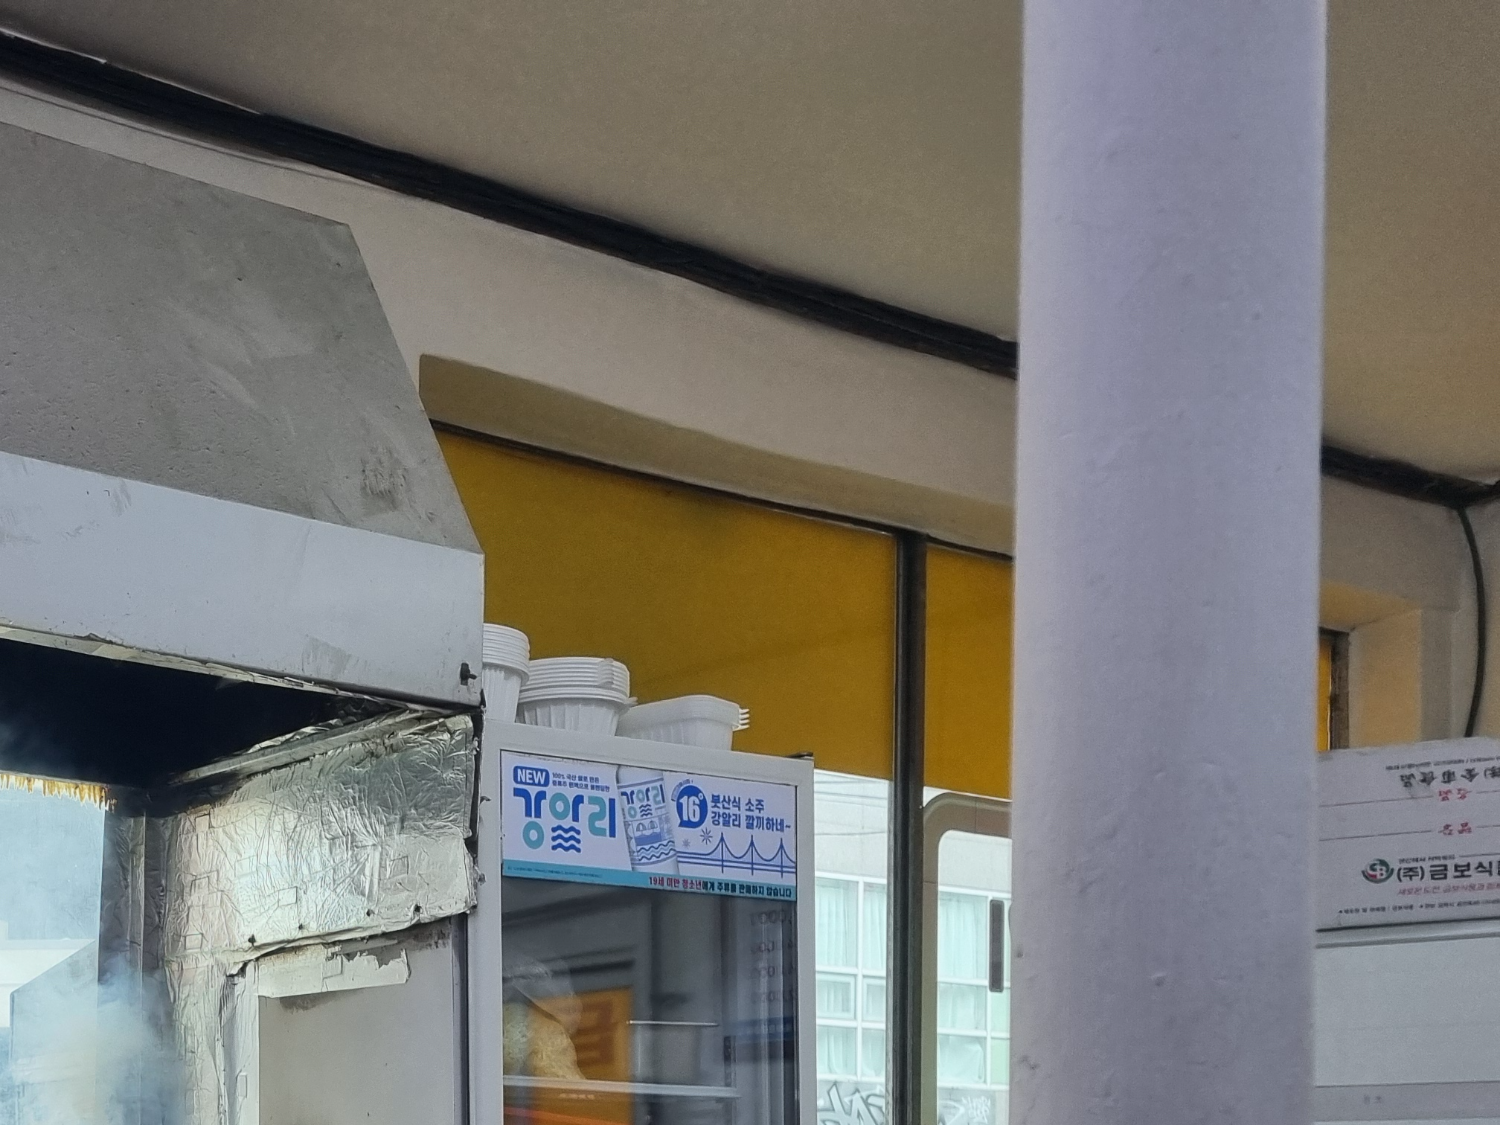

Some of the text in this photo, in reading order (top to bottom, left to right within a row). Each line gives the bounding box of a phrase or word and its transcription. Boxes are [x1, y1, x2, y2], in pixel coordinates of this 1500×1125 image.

[516, 768, 546, 785] NEW
[745, 798, 765, 814] 소주
[711, 811, 741, 828] 강알리
[1397, 860, 1500, 883] (주)금보식
[649, 876, 792, 898] 19세 미만 청소년에게 주류를 판매하지 않습니다
